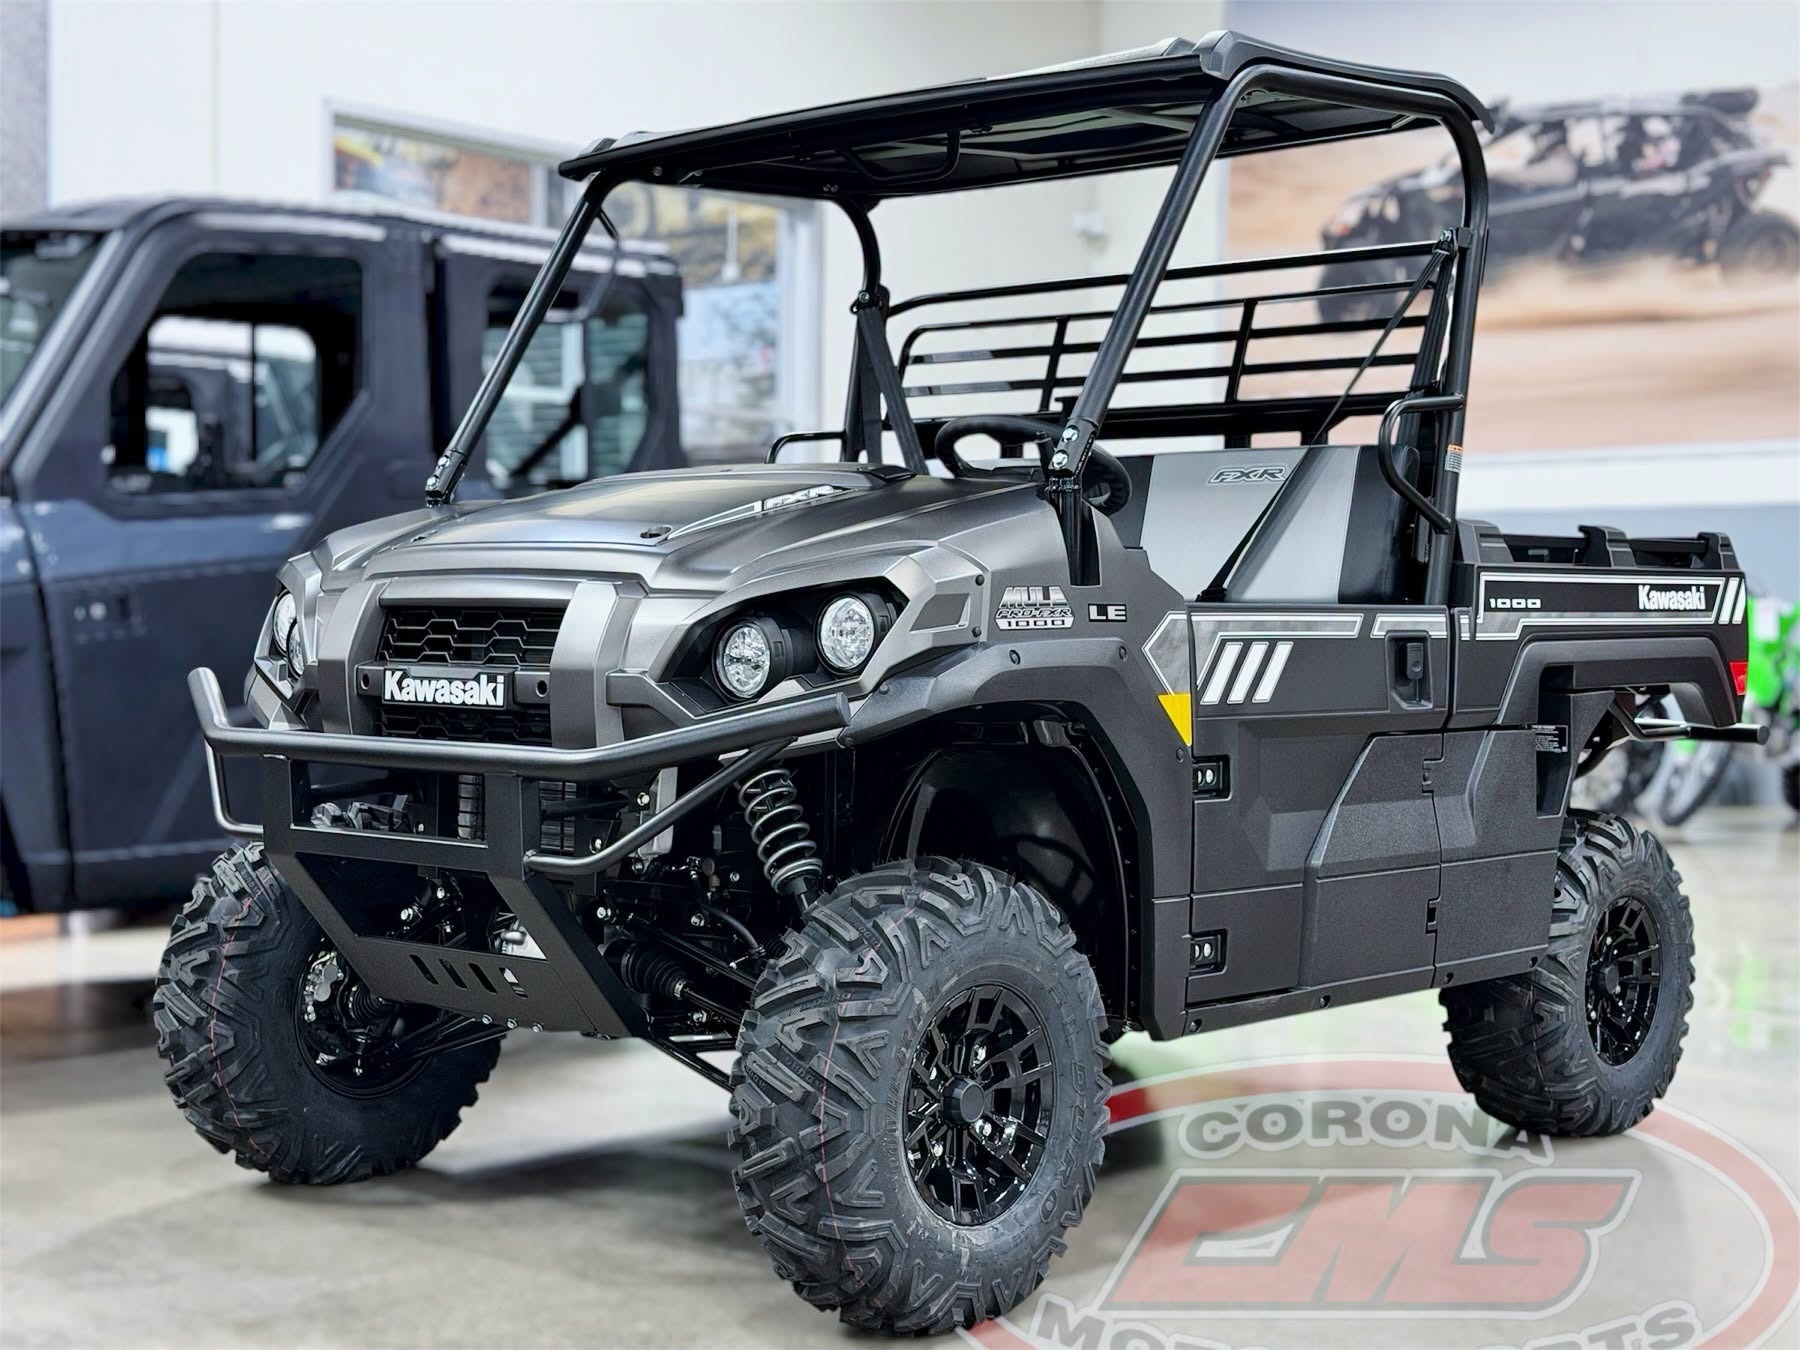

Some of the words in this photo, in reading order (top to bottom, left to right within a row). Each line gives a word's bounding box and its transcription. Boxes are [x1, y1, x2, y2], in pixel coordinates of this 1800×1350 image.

[1208, 466, 1285, 483] FXR
[999, 586, 1069, 608] MULE
[1489, 598, 1541, 609] 1000
[1638, 584, 1706, 610] Kawasaki
[1089, 604, 1126, 620] LE
[1007, 619, 1065, 627] 1000
[384, 670, 504, 706] Kawasaki
